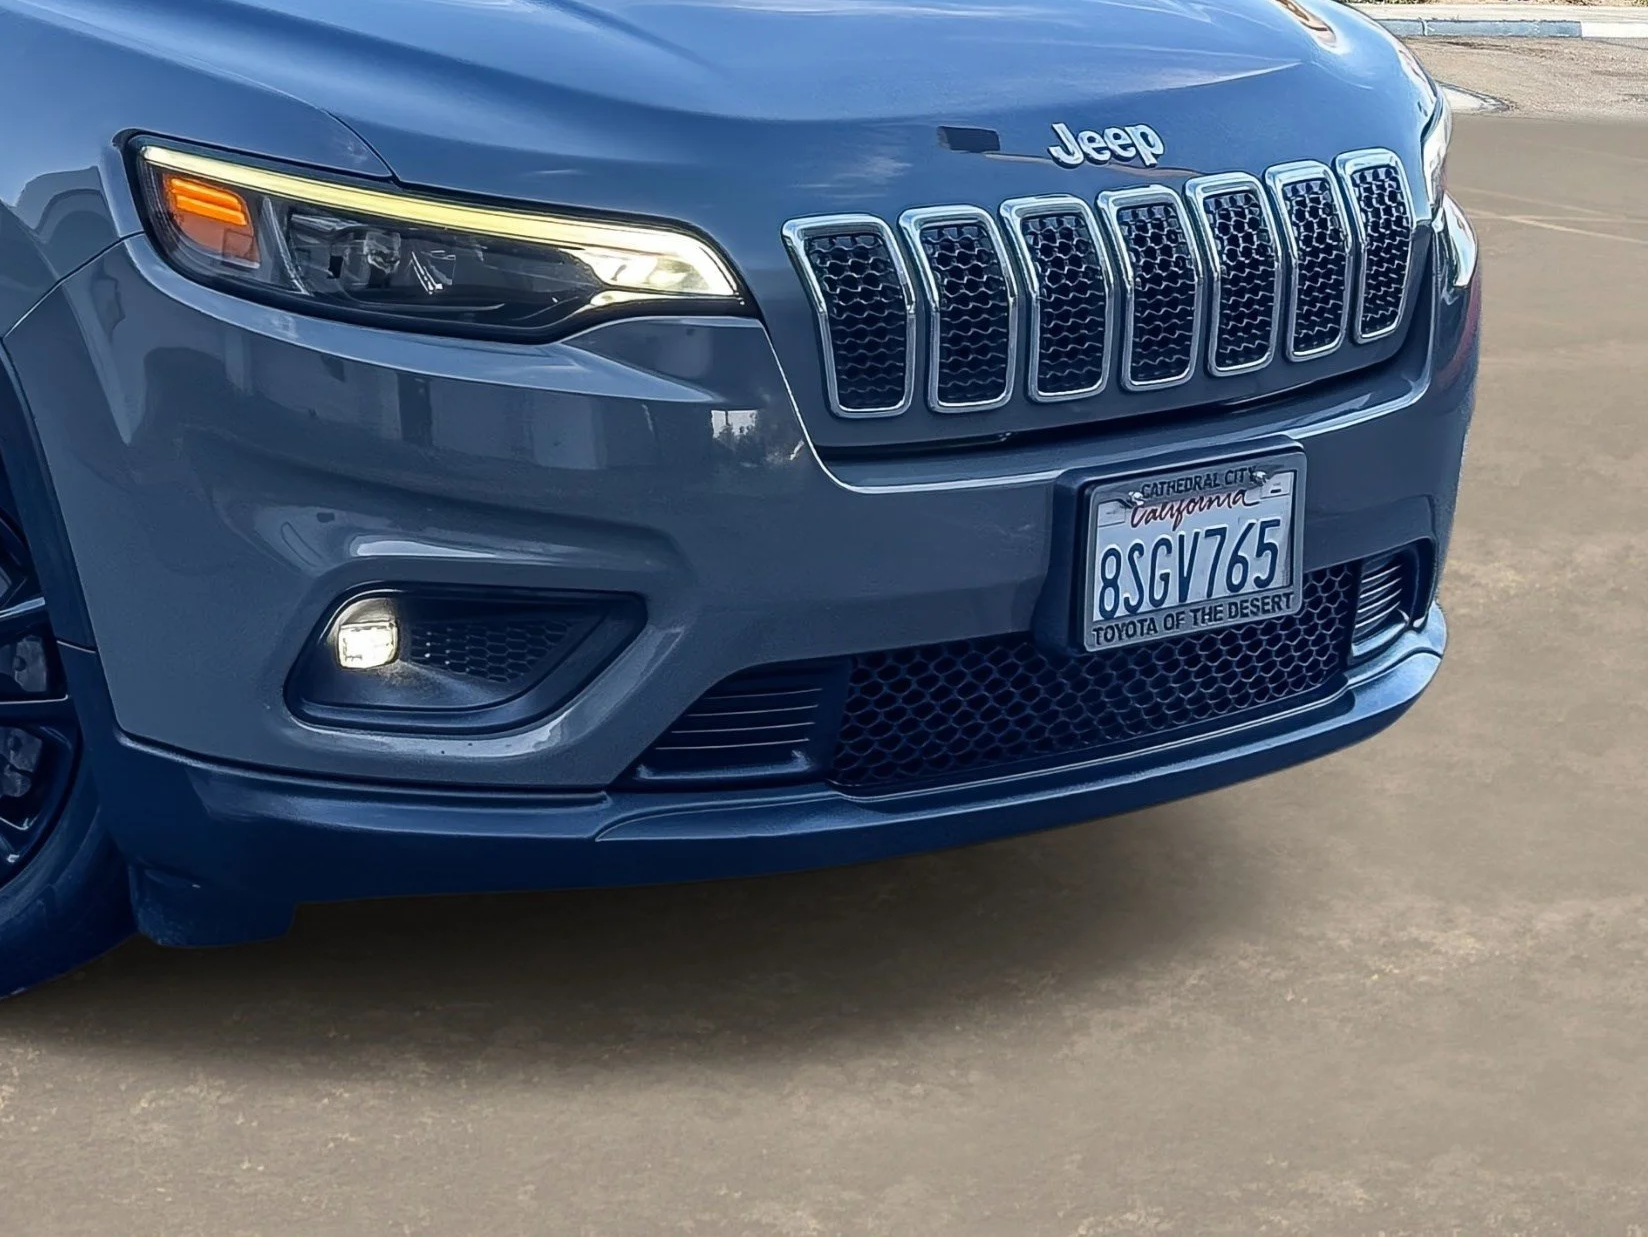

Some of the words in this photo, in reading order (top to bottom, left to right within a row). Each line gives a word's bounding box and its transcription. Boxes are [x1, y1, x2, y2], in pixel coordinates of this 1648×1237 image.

[1048, 122, 1165, 168] Jeep
[1141, 472, 1221, 499] CATHEDRAL
[1224, 465, 1259, 485] CITY
[1130, 488, 1260, 532] California
[1098, 519, 1281, 620] 8SGV765
[1092, 618, 1158, 646] TOYOTA
[1163, 611, 1186, 630] OF
[1190, 604, 1224, 626] THE
[1228, 591, 1294, 620] DESERT
